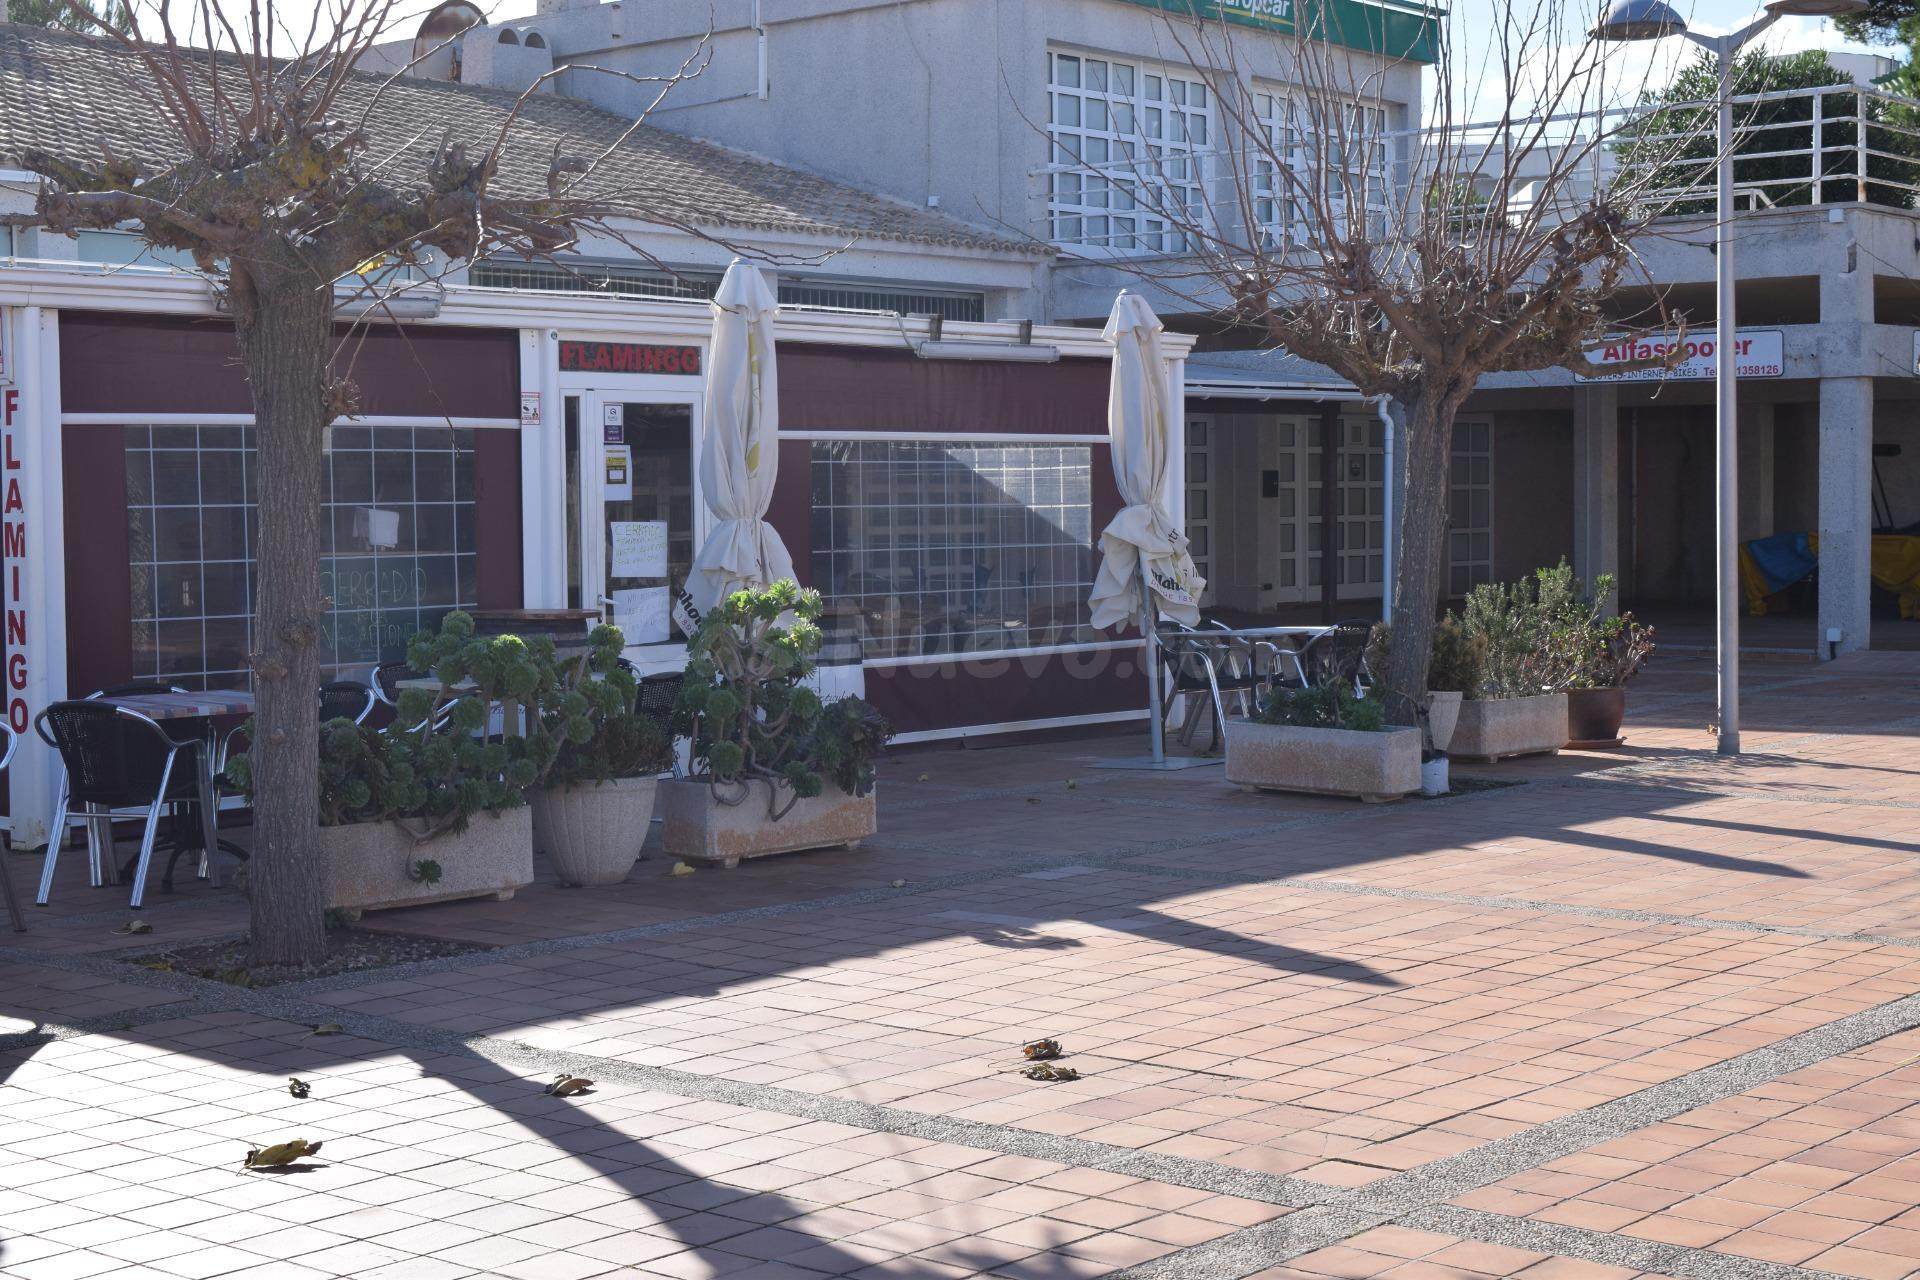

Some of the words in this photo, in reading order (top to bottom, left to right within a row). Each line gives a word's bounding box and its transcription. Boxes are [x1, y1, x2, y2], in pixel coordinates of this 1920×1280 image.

[561, 342, 701, 374] FLAMINGO
[1602, 339, 1753, 360] Alfasoor
[4, 389, 29, 735] FLAMINGO
